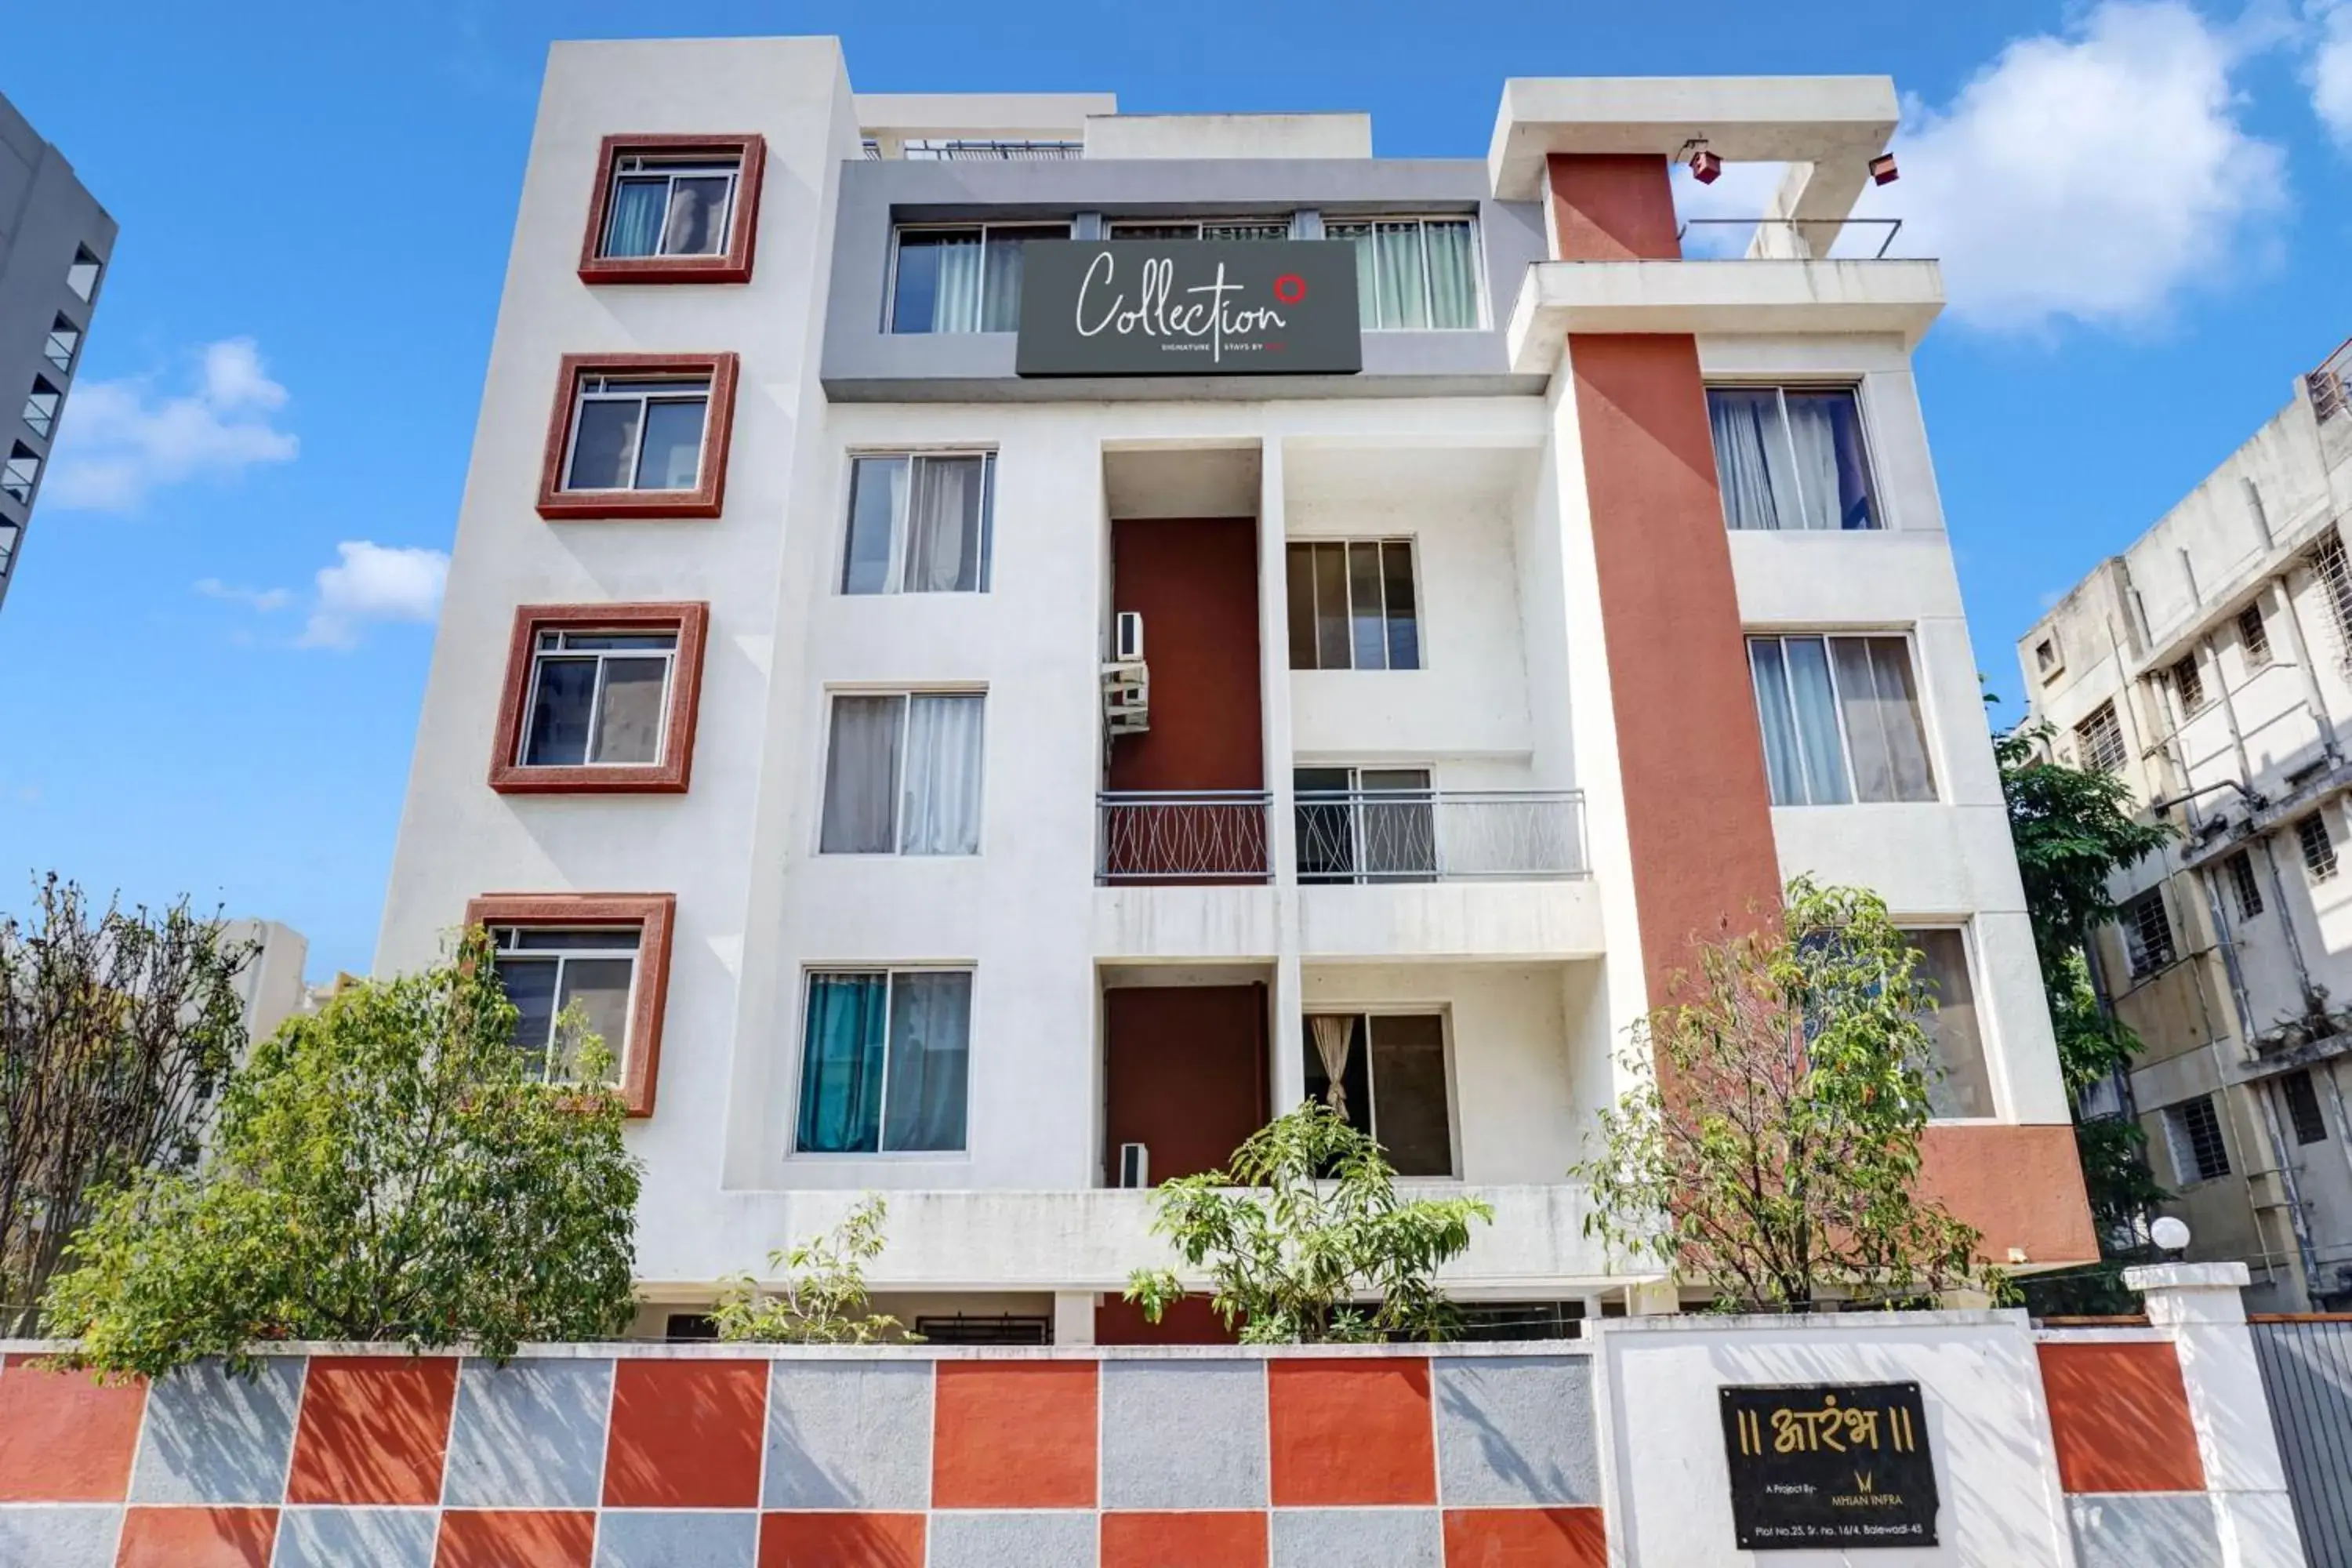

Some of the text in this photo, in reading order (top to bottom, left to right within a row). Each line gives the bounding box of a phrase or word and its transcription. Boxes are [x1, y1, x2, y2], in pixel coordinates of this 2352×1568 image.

[1076, 251, 1287, 364] Collection
[1161, 343, 1210, 351] SIGNATURE
[1224, 343, 1250, 351] STAYS
[1252, 343, 1264, 351] BY
[1773, 1483, 1802, 1495] Project
